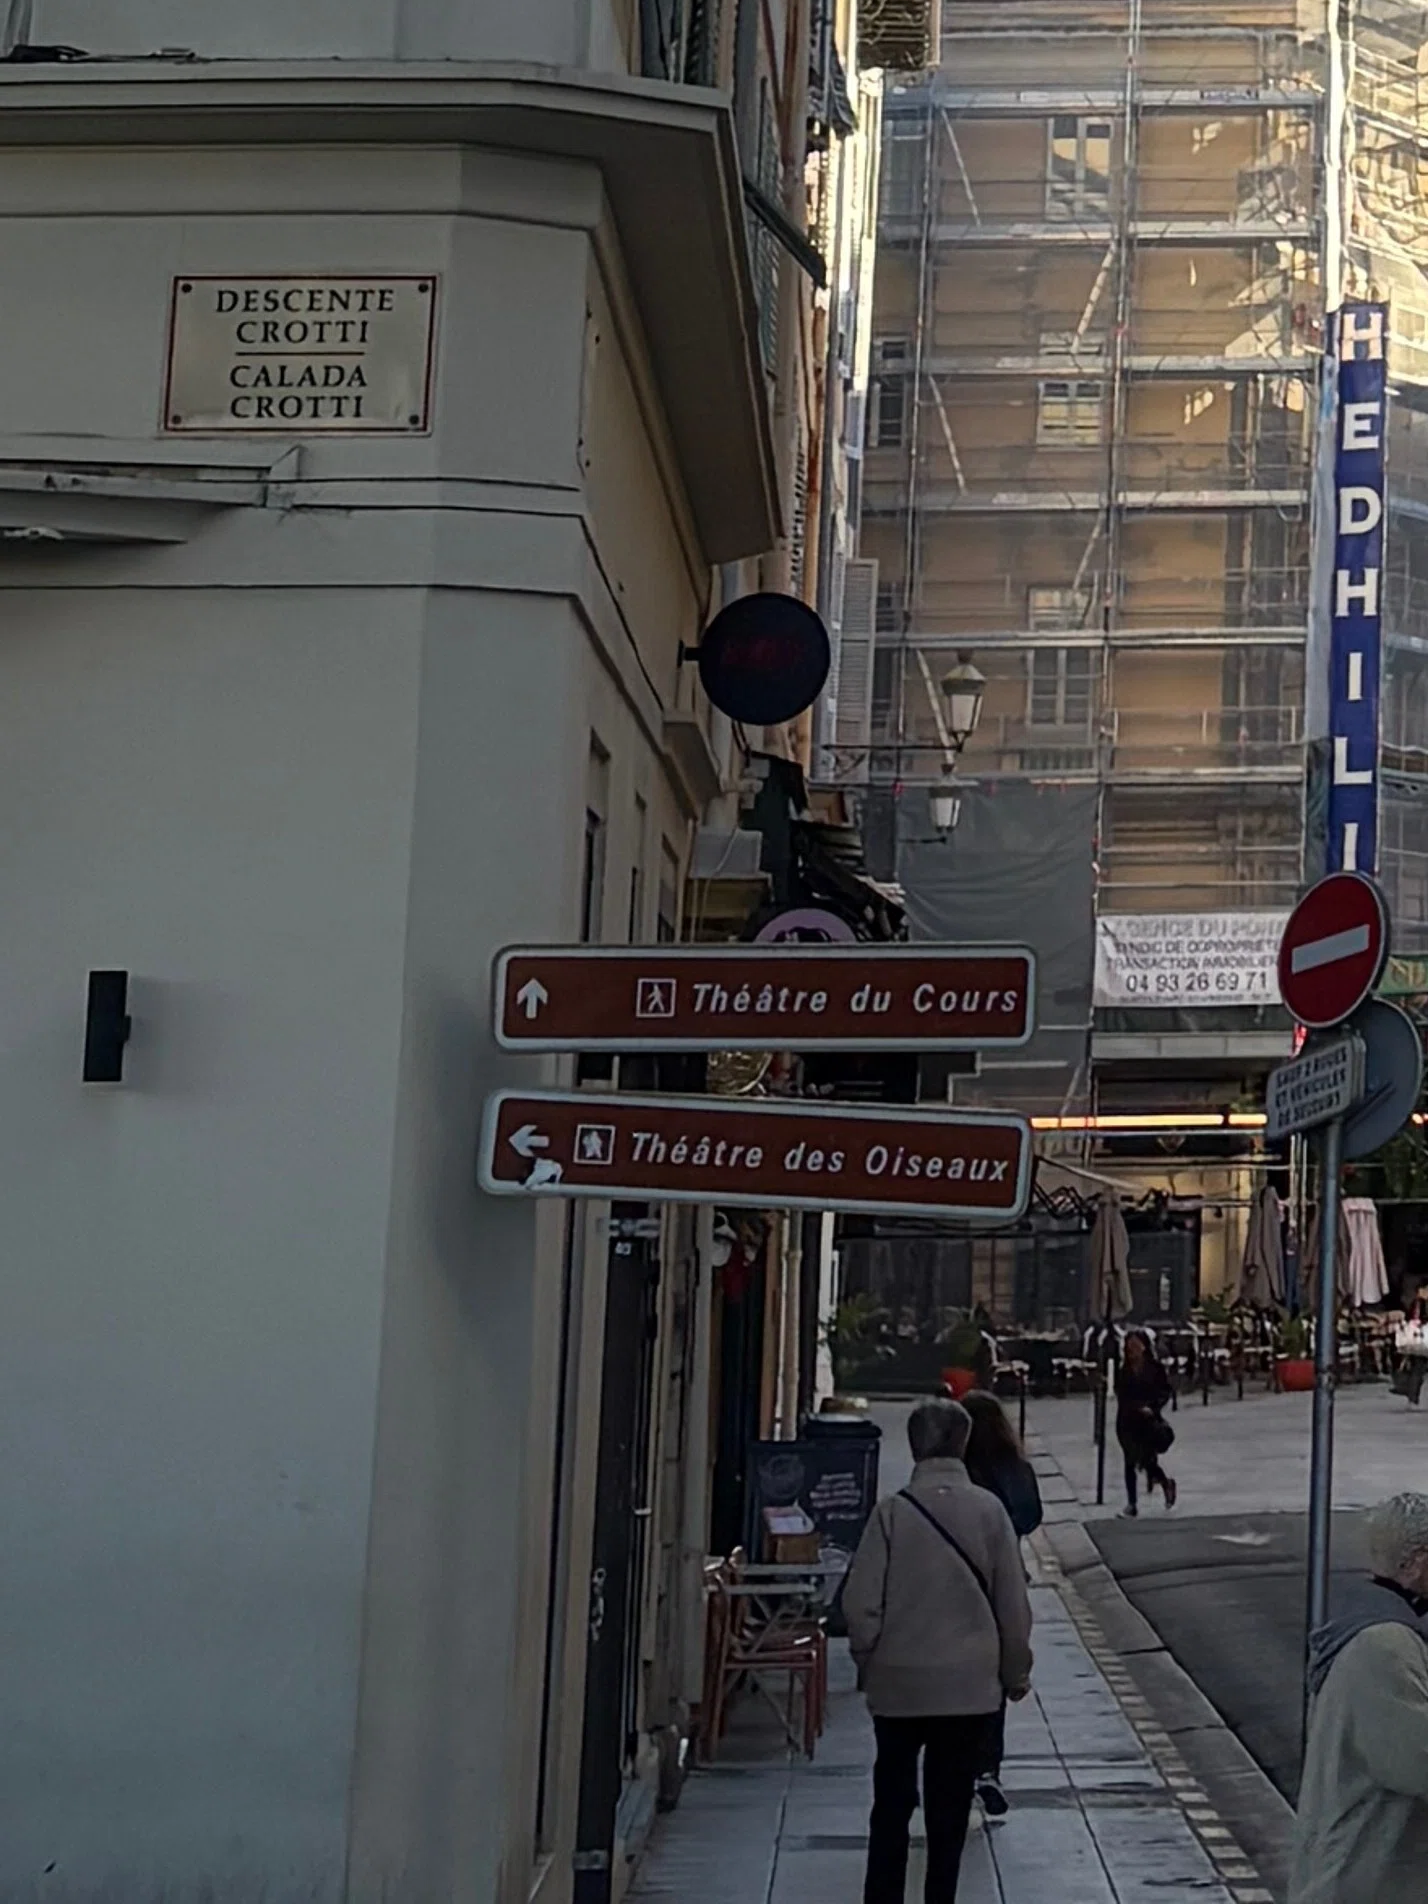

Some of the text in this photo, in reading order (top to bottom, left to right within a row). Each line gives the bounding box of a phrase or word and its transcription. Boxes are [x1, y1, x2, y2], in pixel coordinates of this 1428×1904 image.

[215, 288, 395, 313] DESCENTE
[235, 319, 370, 344] CROTTI
[229, 364, 368, 388] CALADA
[230, 395, 364, 419] CROTTI
[1331, 311, 1382, 871] HEDHILI
[1125, 971, 1267, 993] 04 93 26 69 71
[692, 982, 1018, 1014] Théâtre du Cours
[630, 1131, 765, 1170] Théâtre
[783, 1140, 845, 1174] des
[865, 1144, 1010, 1182] Oiseaux
